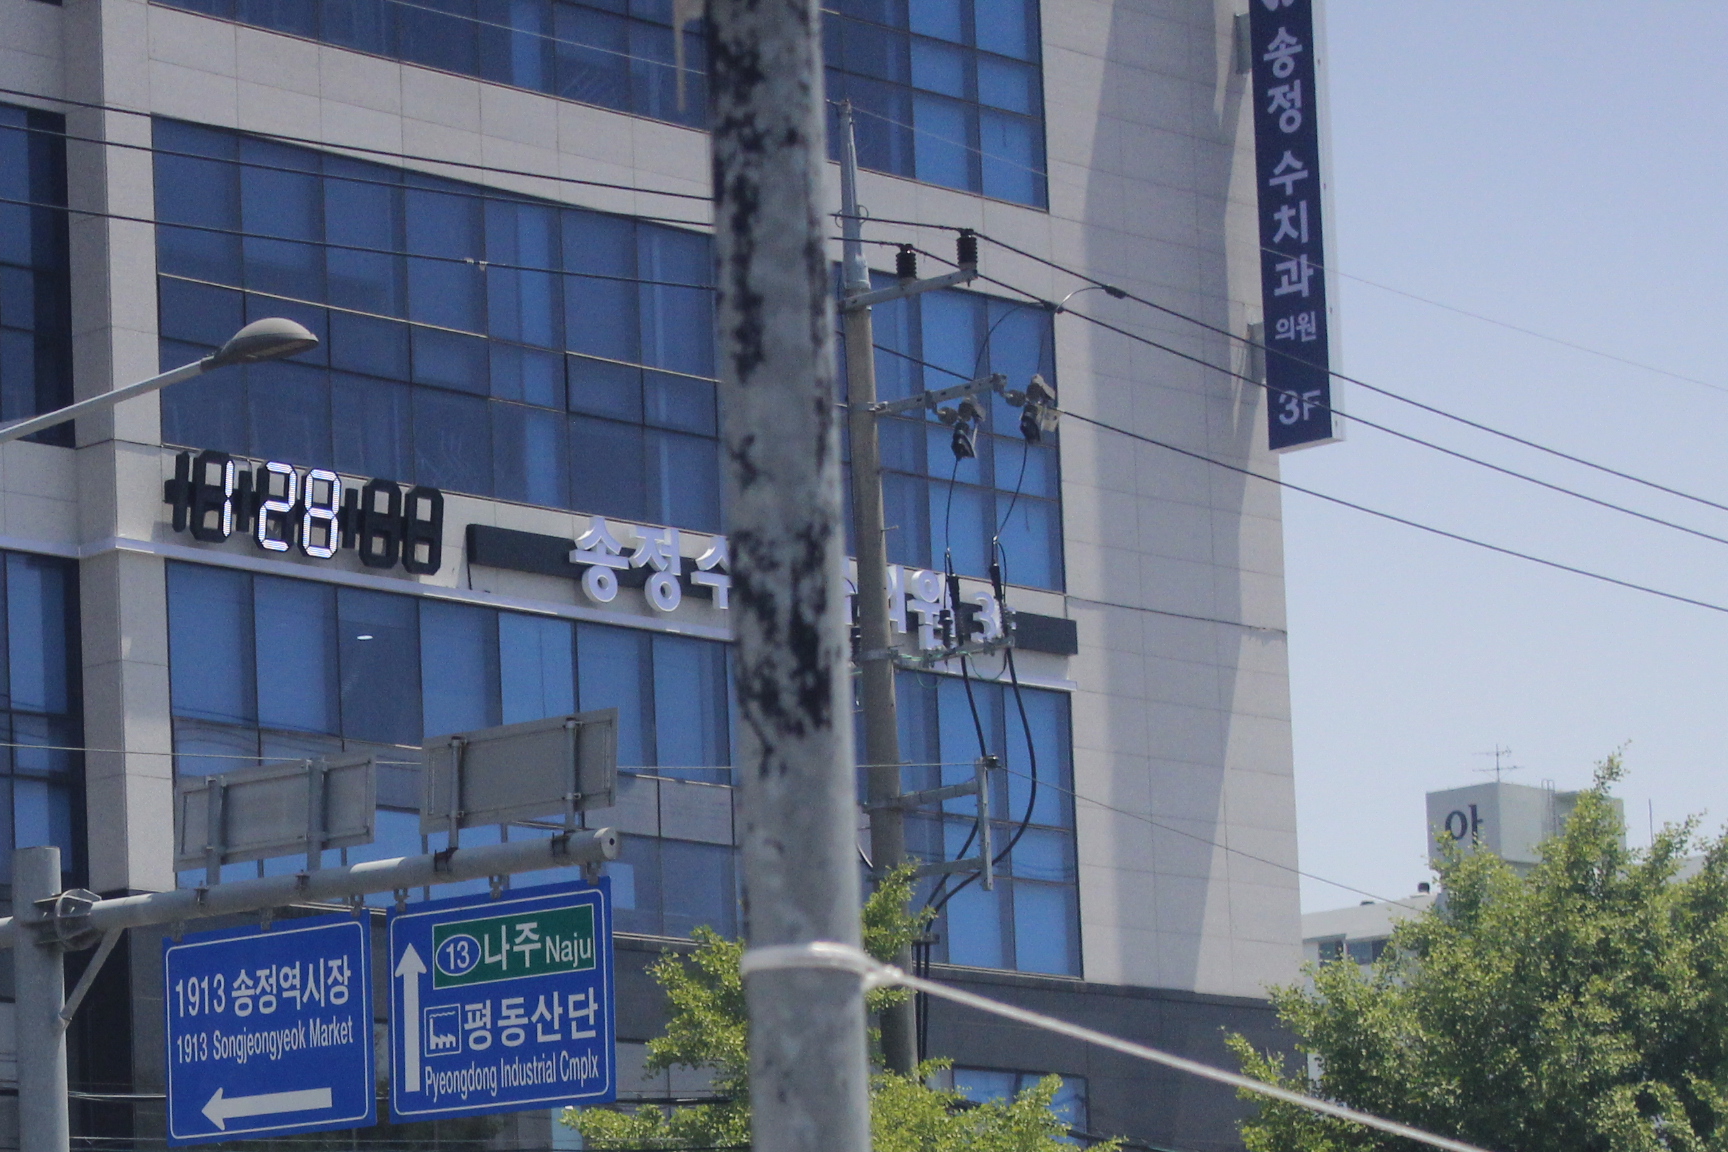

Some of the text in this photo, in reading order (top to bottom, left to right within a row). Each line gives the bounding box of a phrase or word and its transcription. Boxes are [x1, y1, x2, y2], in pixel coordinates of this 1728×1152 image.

[1278, 390, 1321, 426] 3F
[444, 921, 592, 971] 13 나주 Naju
[174, 954, 352, 1018] 1913 송정역시장
[176, 1014, 354, 1066] 1913 Songjeongyeok Market
[463, 986, 599, 1052] 평동산단
[424, 1047, 600, 1103] Pyeongdong Industrial Cmplx
